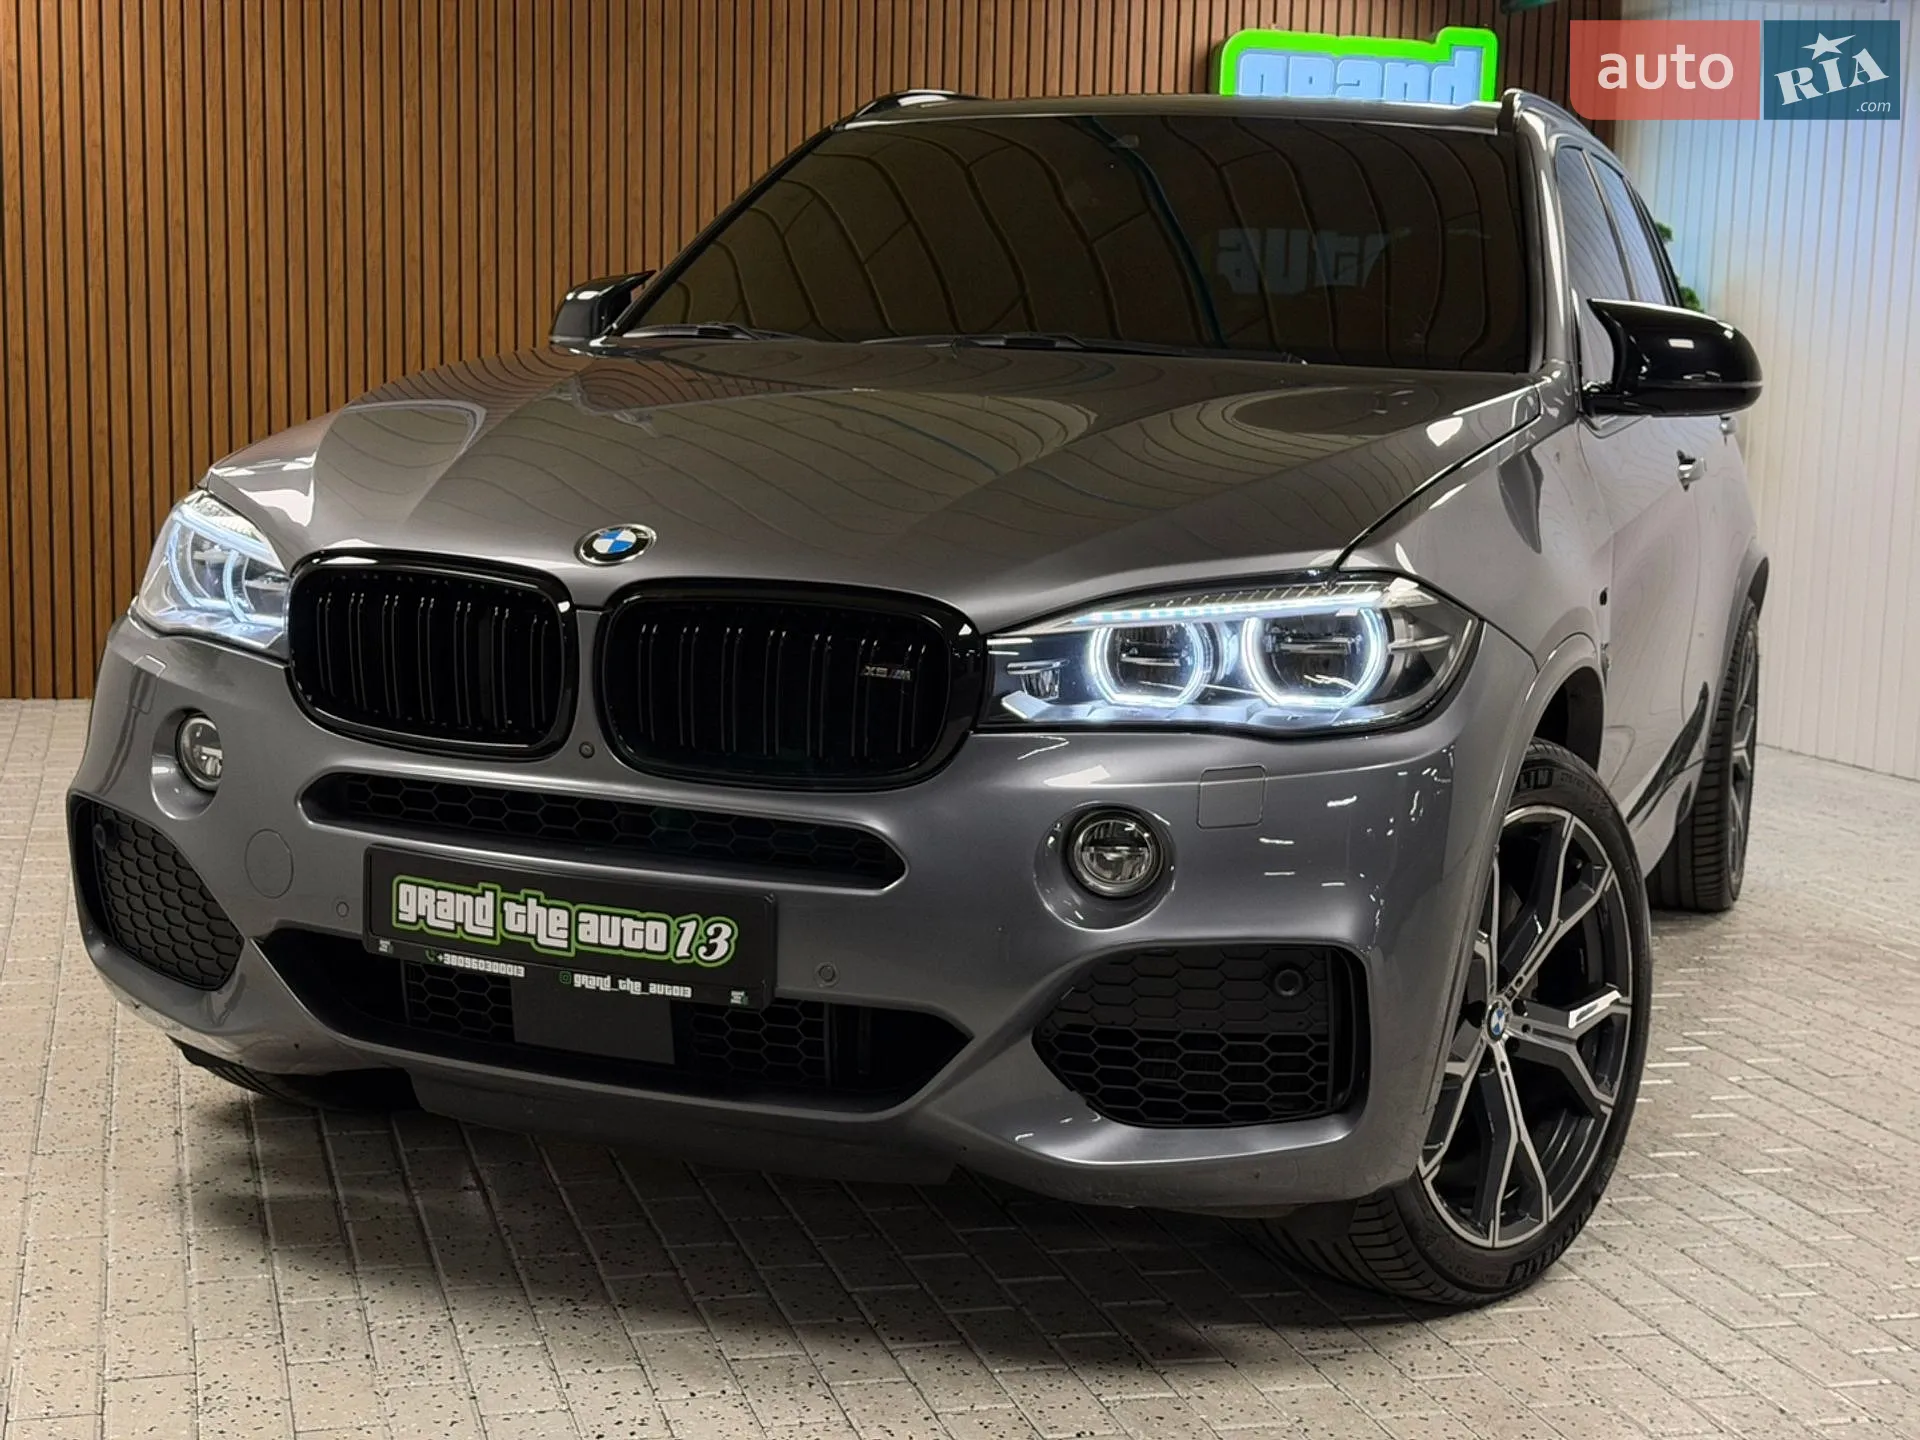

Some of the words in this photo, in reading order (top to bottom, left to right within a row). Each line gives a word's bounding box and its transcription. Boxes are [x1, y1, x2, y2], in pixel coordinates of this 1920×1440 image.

[398, 883, 494, 937] grand
[503, 897, 568, 948] the
[573, 973, 692, 998] grand_the_auto13
